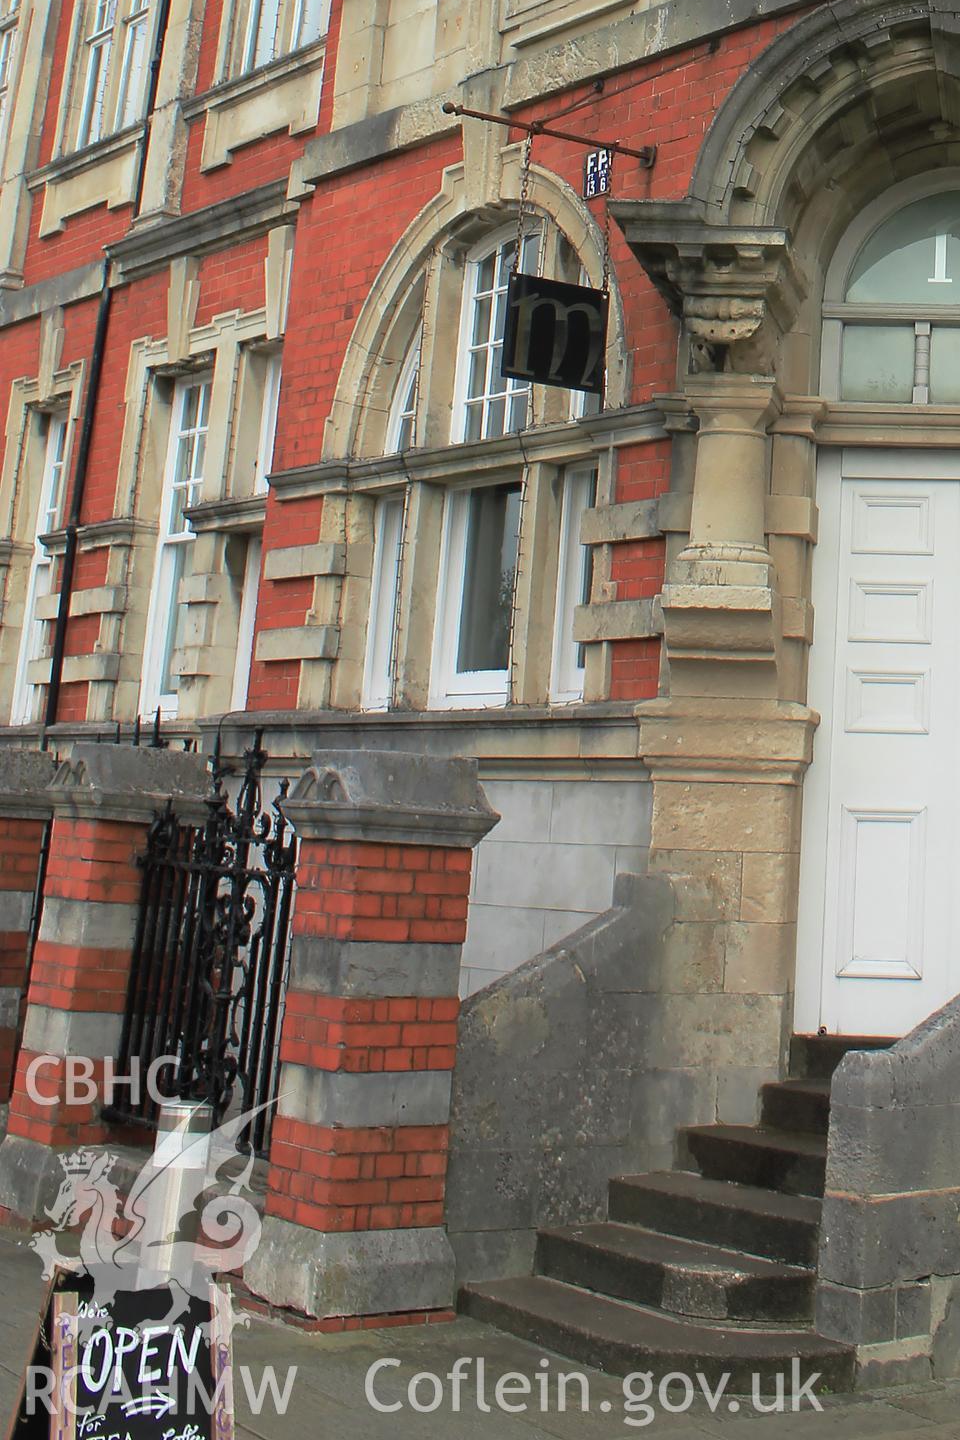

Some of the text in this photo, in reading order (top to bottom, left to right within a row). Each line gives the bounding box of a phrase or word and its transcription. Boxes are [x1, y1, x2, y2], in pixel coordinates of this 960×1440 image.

[600, 177, 606, 192] 6
[82, 1325, 202, 1392] OPEN
[76, 1411, 106, 1437] for
